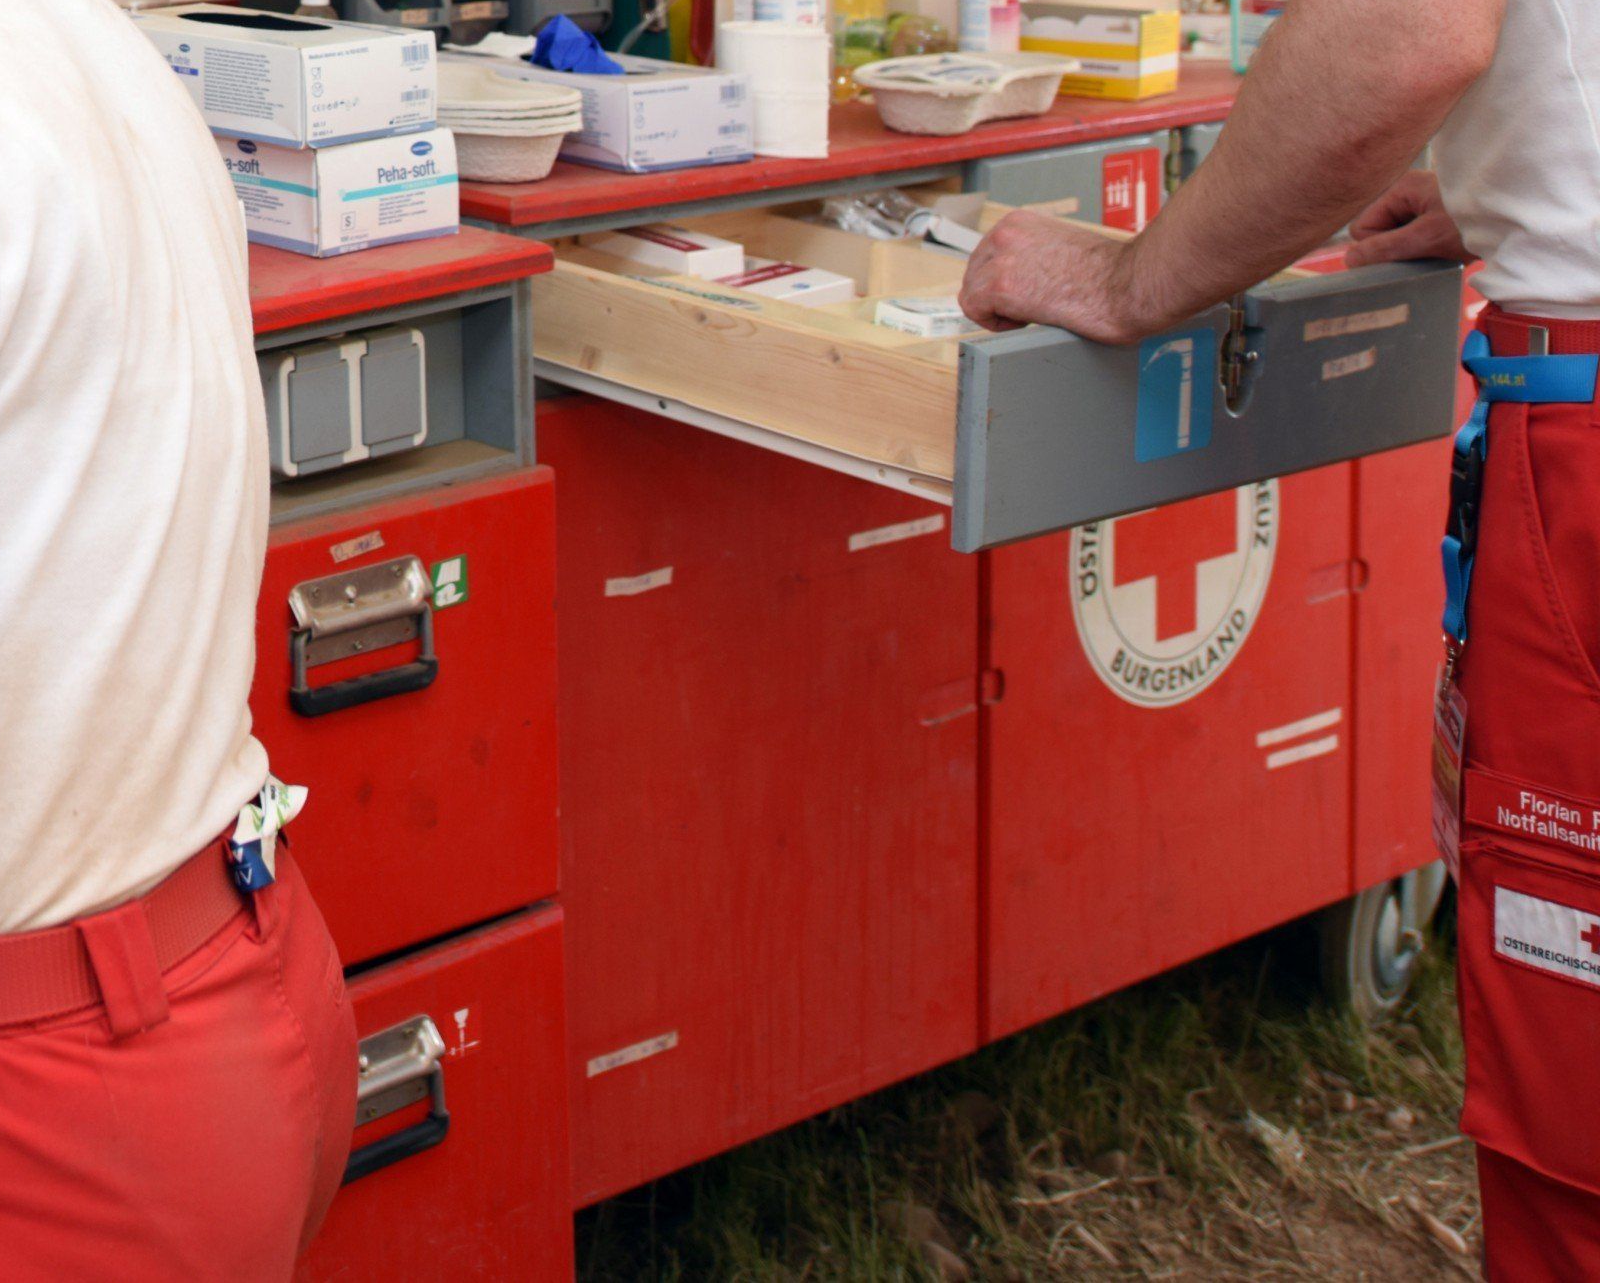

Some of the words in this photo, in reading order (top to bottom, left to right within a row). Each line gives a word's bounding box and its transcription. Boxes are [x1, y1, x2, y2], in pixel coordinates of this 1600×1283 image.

[377, 159, 436, 184] Peha-soft
[344, 215, 352, 227] S
[1253, 479, 1272, 550] EUZ
[1111, 609, 1247, 693] BURGENLAND
[1520, 790, 1582, 826] Florian
